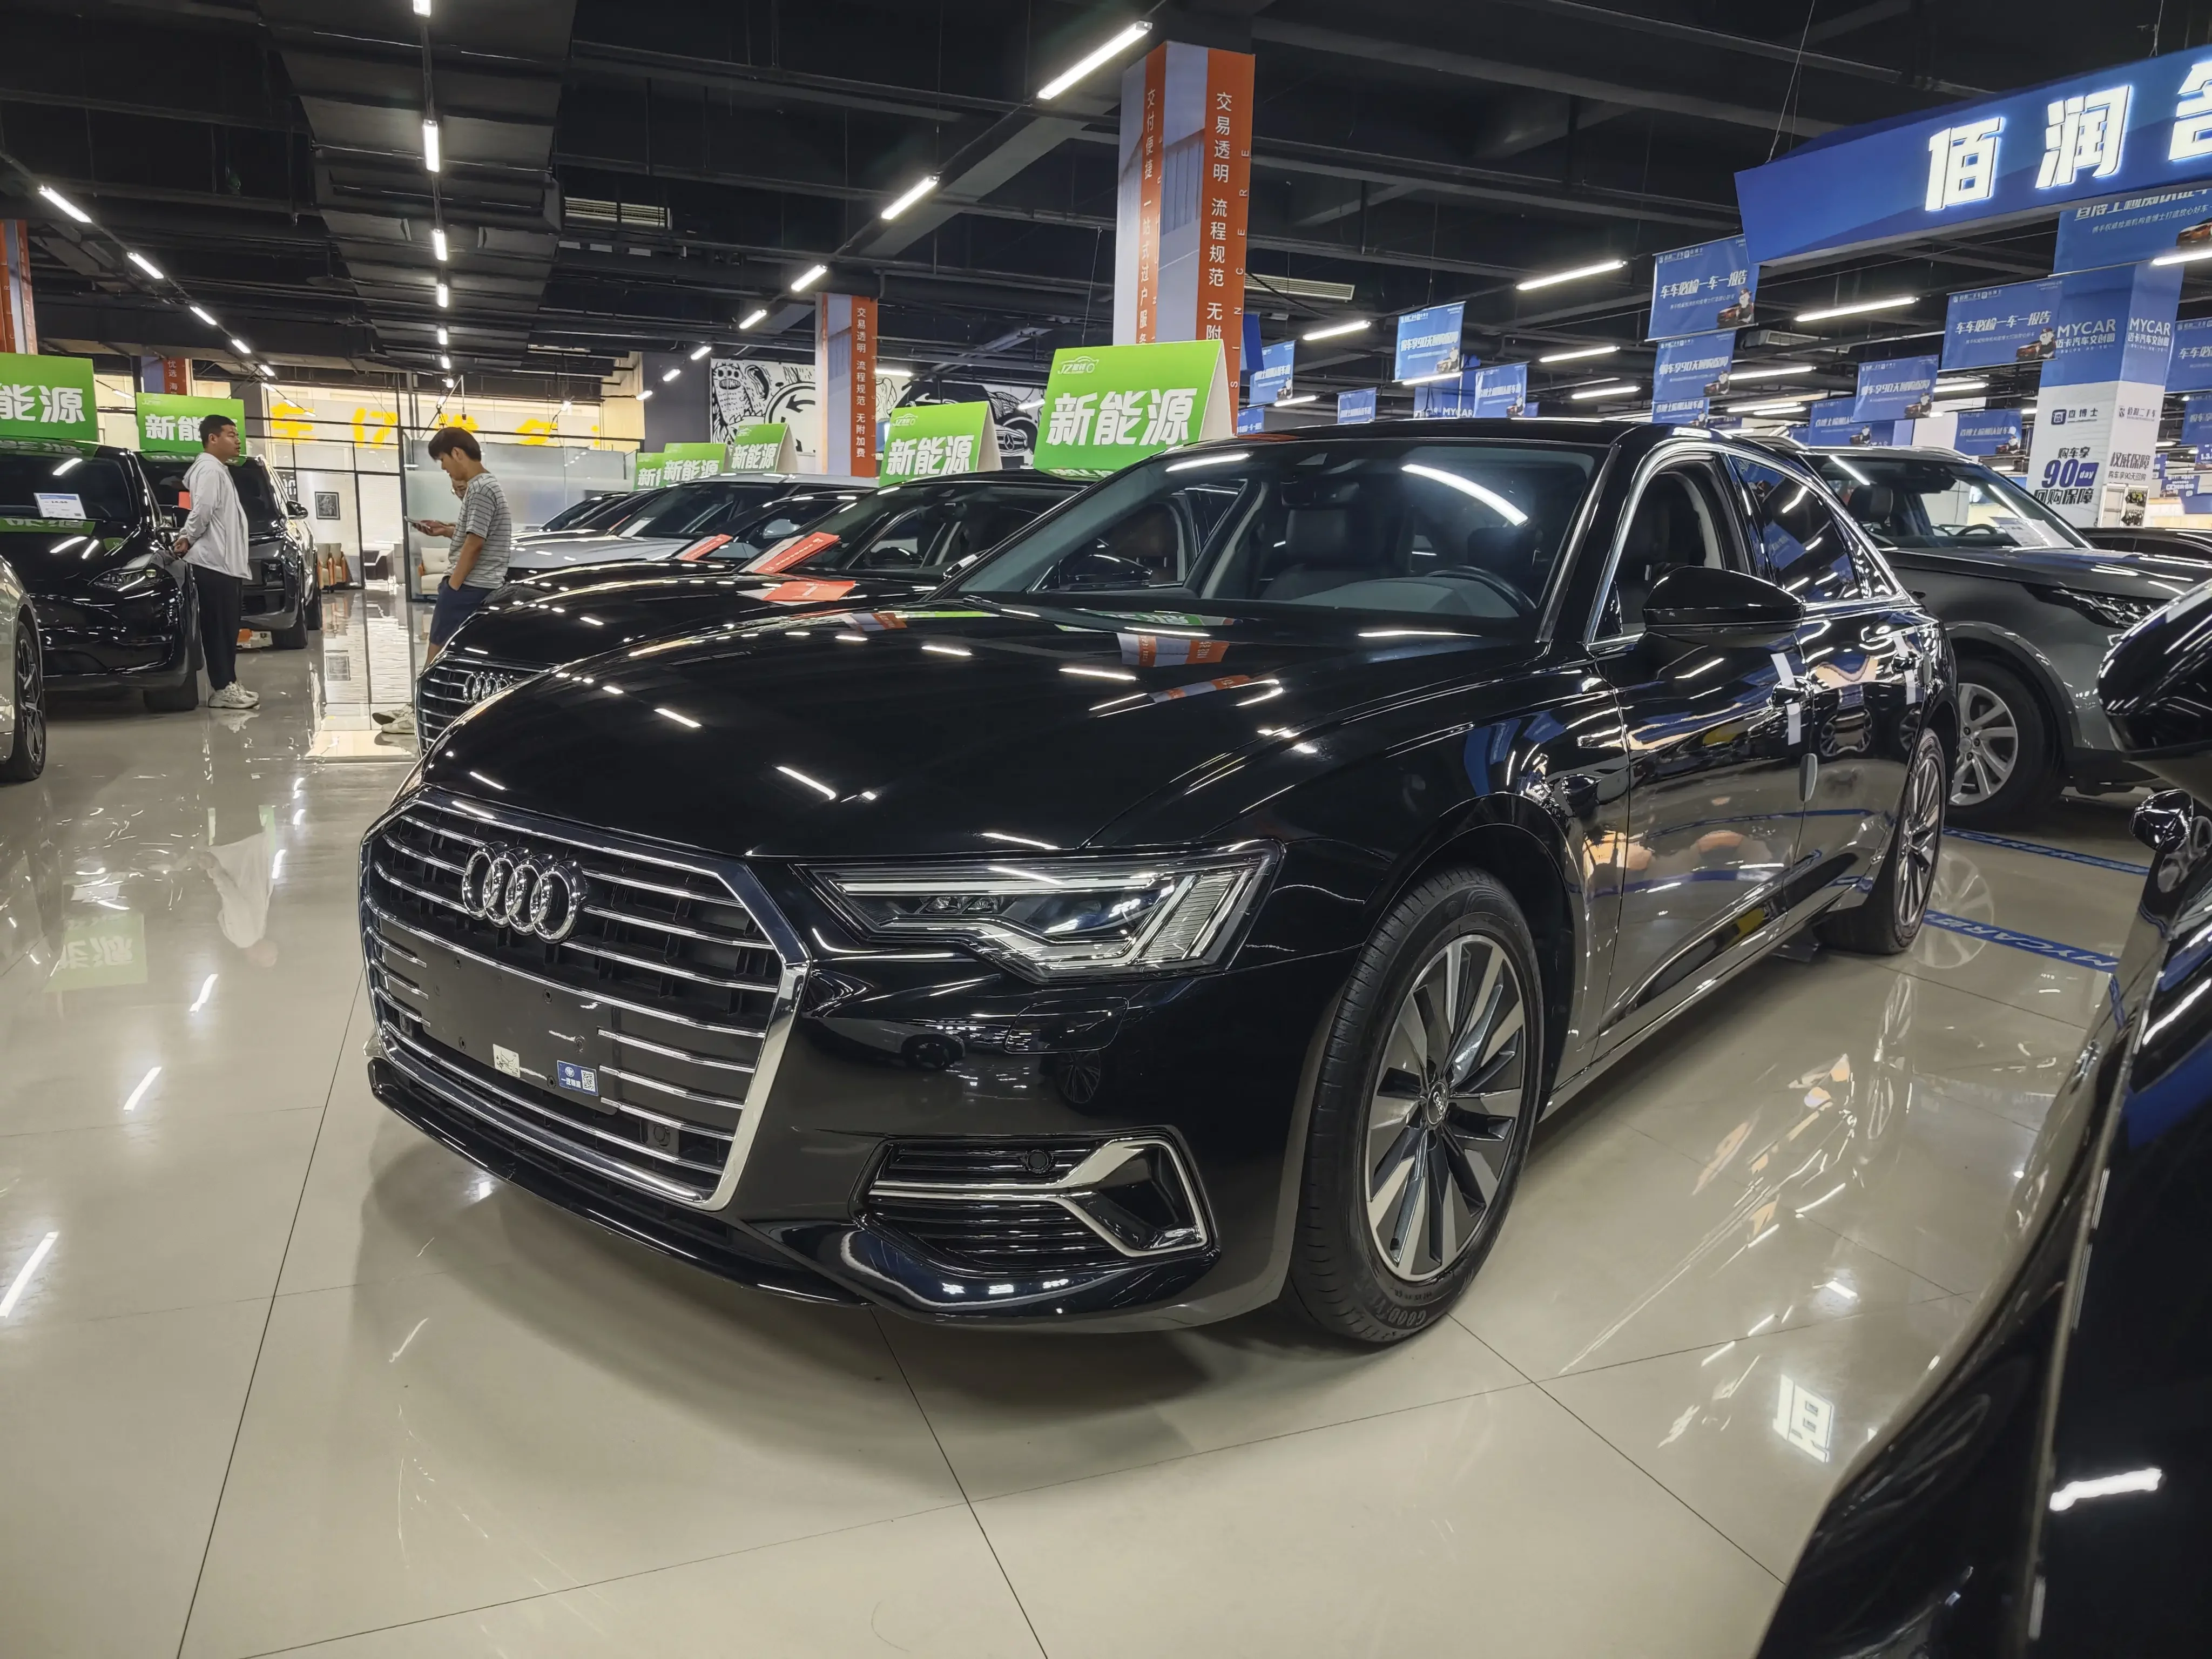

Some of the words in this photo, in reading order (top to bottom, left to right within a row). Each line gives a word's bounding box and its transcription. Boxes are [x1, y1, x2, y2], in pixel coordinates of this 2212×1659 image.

[1144, 88, 1156, 180] 交付便捷
[1213, 91, 1232, 183] 交易透明
[1208, 198, 1228, 287] 流程规范
[857, 307, 867, 354] 交易透明
[2057, 319, 2116, 338] MYCAR
[2129, 318, 2171, 336] MYCAR
[170, 382, 178, 395] 海
[856, 360, 866, 406] 流程规范
[1046, 388, 1198, 446] 新能源
[2068, 407, 2099, 419] 查博士
[855, 413, 866, 458] 无附加费
[731, 443, 779, 469] 新能源
[886, 434, 975, 476] 新能源
[2058, 446, 2091, 459] 购车享
[2109, 451, 2152, 470] 权威保障
[663, 459, 720, 481] 新能源
[2041, 458, 2080, 488] 90
[2079, 470, 2095, 480] day
[2034, 487, 2095, 506] 回购保障
